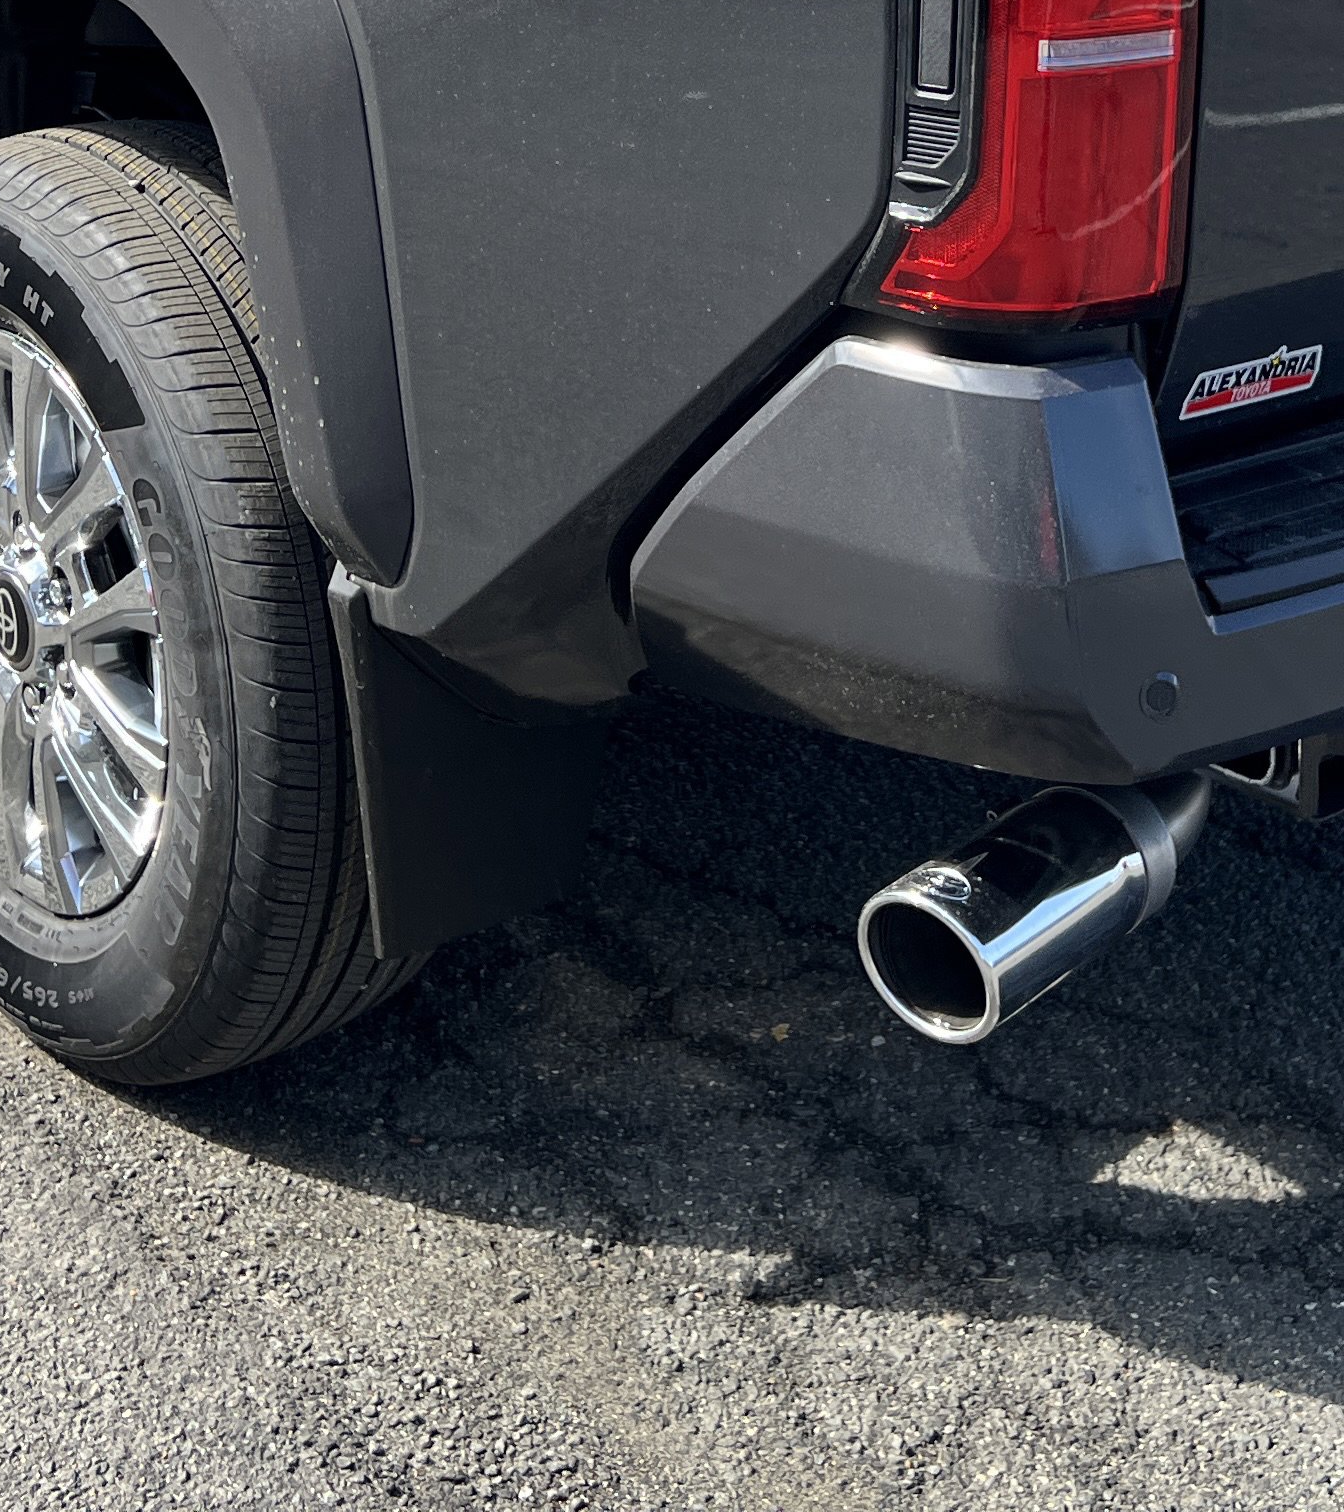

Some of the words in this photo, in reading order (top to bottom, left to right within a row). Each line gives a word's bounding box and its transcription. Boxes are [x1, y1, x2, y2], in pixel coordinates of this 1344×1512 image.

[22, 284, 55, 327] HT
[1189, 350, 1318, 400] ALEXANDRIA
[1230, 378, 1273, 402] TOYOTA
[132, 477, 202, 947] GOODYEAR
